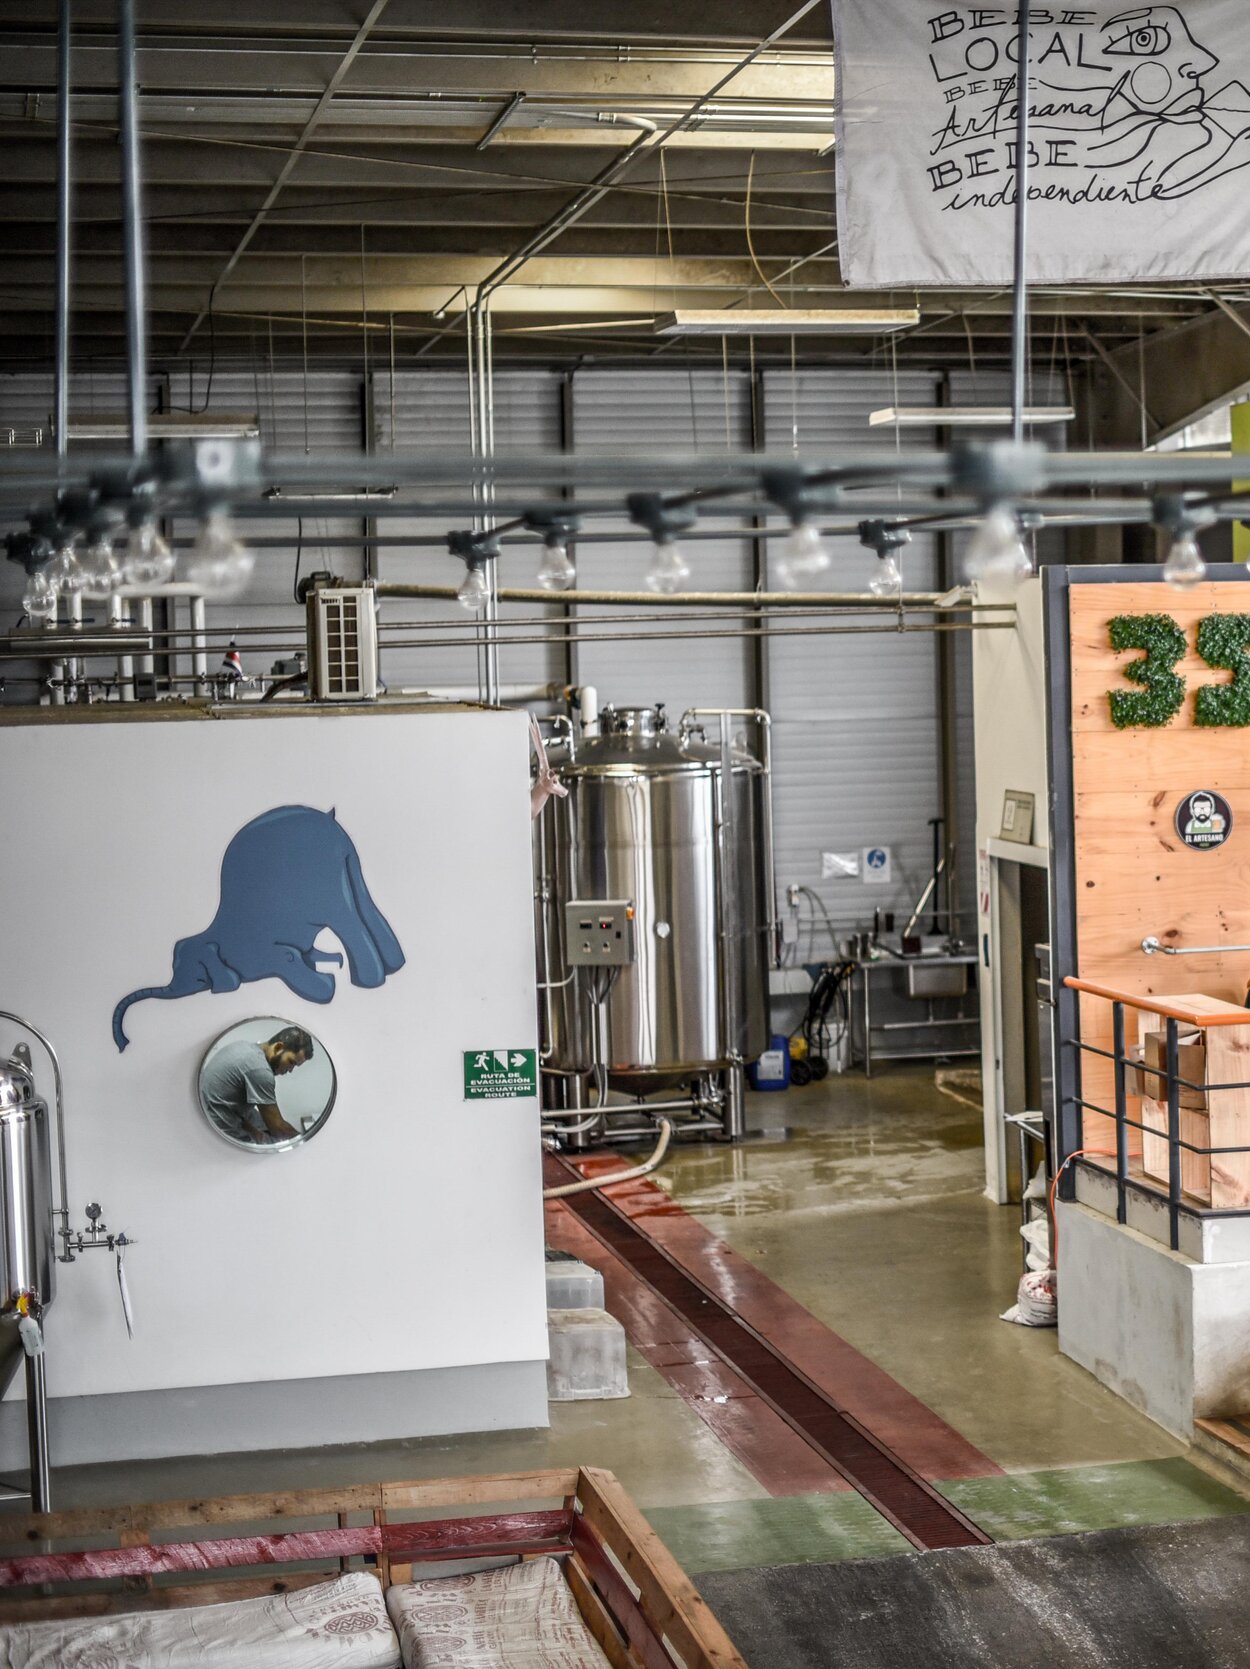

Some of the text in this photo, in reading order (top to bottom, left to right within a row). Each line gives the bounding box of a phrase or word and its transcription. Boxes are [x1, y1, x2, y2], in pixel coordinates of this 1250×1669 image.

[927, 10, 1097, 43] BEBE
[929, 31, 1112, 82] LOCAL
[927, 139, 1078, 192] BEBE
[1185, 834, 1224, 843] EL ARTESANO
[470, 1077, 531, 1086] EVACUACIÓN
[470, 1085, 531, 1093] EVACUATION
